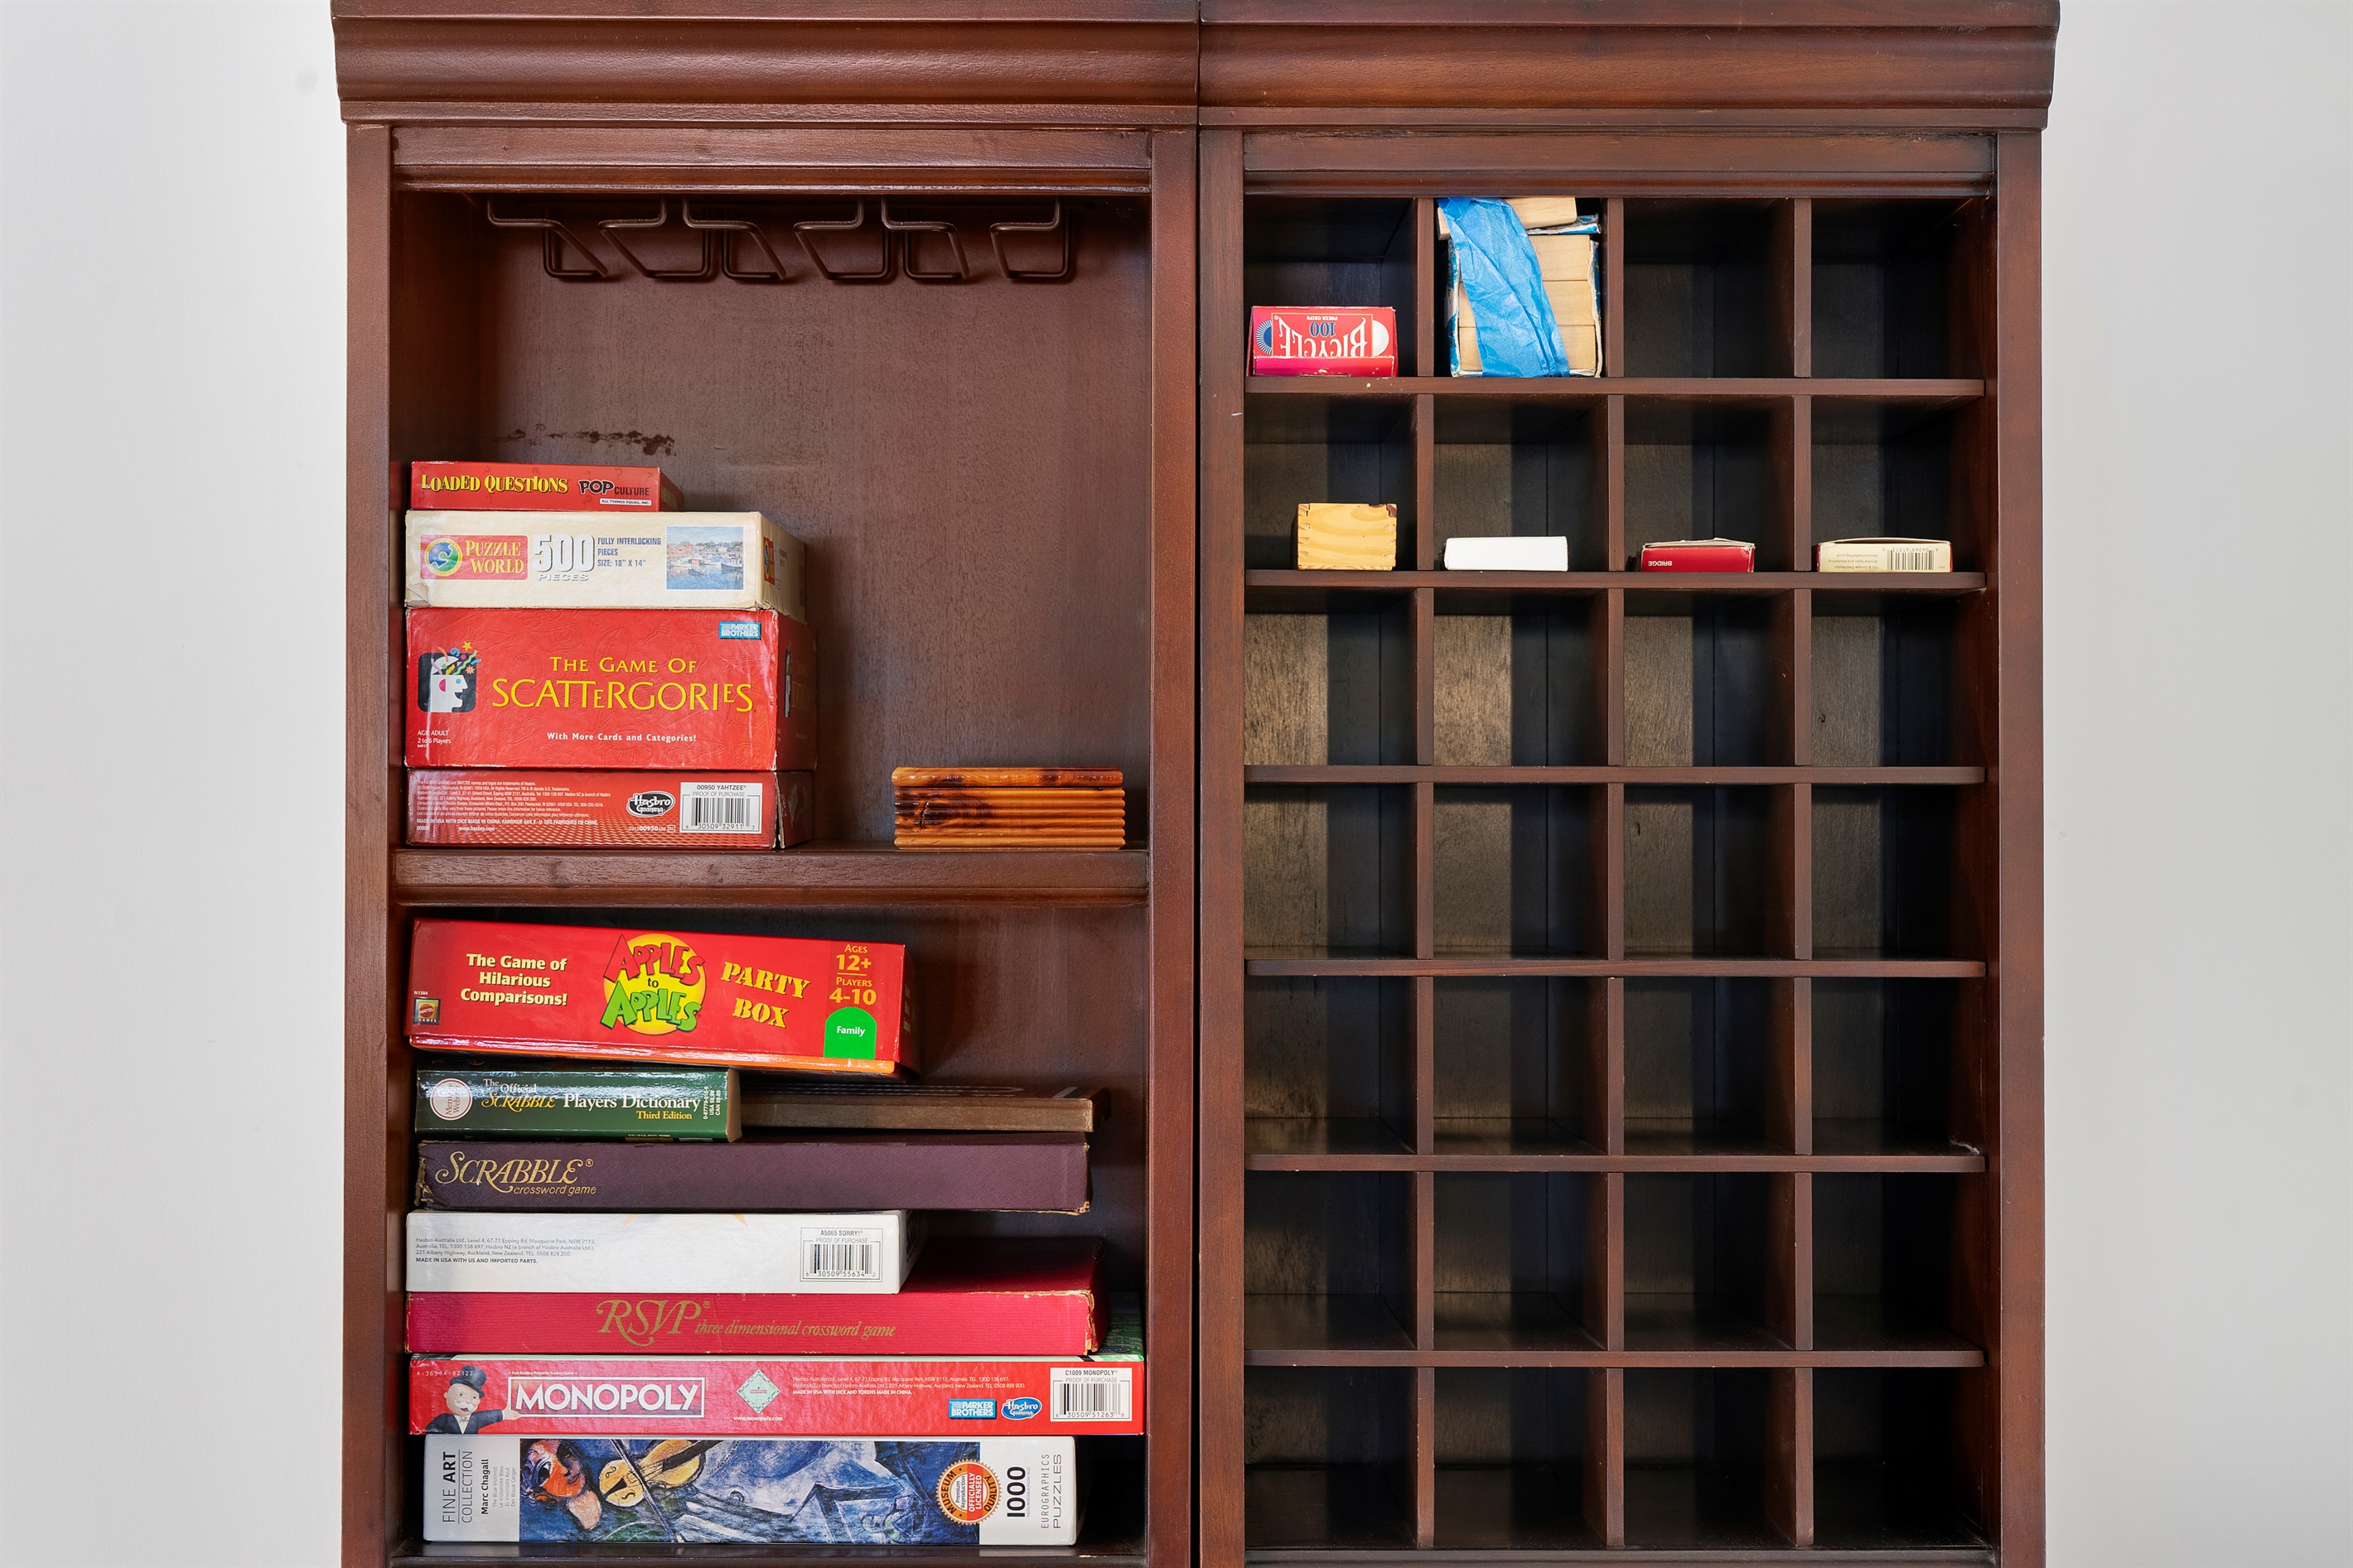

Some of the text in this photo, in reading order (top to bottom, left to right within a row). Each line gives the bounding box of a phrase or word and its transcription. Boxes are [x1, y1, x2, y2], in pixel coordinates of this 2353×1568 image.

[1308, 322, 1336, 337] 100
[421, 474, 569, 494] LOADED QUESTIONS
[578, 480, 650, 496] POP CULTURE
[465, 540, 522, 557] PUZZLE
[597, 537, 662, 545] FULLY INTERLOCKING
[533, 533, 595, 573] 500
[470, 557, 525, 574] WORLD
[538, 573, 589, 581] PIECES
[549, 656, 697, 673] THE GAME OF
[492, 678, 754, 712] SCATTERGORIES
[572, 732, 594, 741] More
[597, 732, 622, 741] Cards
[626, 733, 642, 741] and
[646, 733, 697, 743] Categories!
[631, 793, 672, 808] Hasbro
[636, 803, 664, 814] Gaming
[844, 944, 868, 954] AGES
[466, 953, 568, 972] The Game of
[603, 934, 705, 986] APPLES
[835, 954, 872, 972] 12+
[479, 972, 551, 988] Hilarious
[647, 977, 660, 988] to
[720, 961, 810, 999] PARTY
[836, 977, 872, 987] PLAYERS
[460, 988, 568, 1006] Comparisons!
[829, 988, 877, 1006] 4-10
[600, 981, 702, 1032] APPLES
[732, 997, 790, 1028] BOX
[836, 1025, 866, 1037] Family
[500, 1083, 537, 1093] Official
[481, 1091, 702, 1112] SCRABBLE Players Dictionary
[636, 1110, 693, 1120] Third Edition
[513, 1184, 597, 1197] crossword game
[694, 1320, 723, 1335] three
[724, 1320, 800, 1336] dimensional
[802, 1322, 860, 1337] crossword
[861, 1325, 896, 1341] game
[515, 1383, 699, 1411] MONOPOLY
[1004, 1400, 1039, 1411] Hasbro
[481, 1459, 490, 1491] Chagall
[442, 1451, 456, 1522] FINE ART
[462, 1451, 473, 1523] COLLECTION
[941, 1470, 957, 1514] MUSEUM
[984, 1475, 997, 1512] QUALITY
[1007, 1467, 1026, 1517] 1000
[1041, 1454, 1049, 1529] EUROGRAPHICS
[1053, 1454, 1062, 1529] PUZZLES
